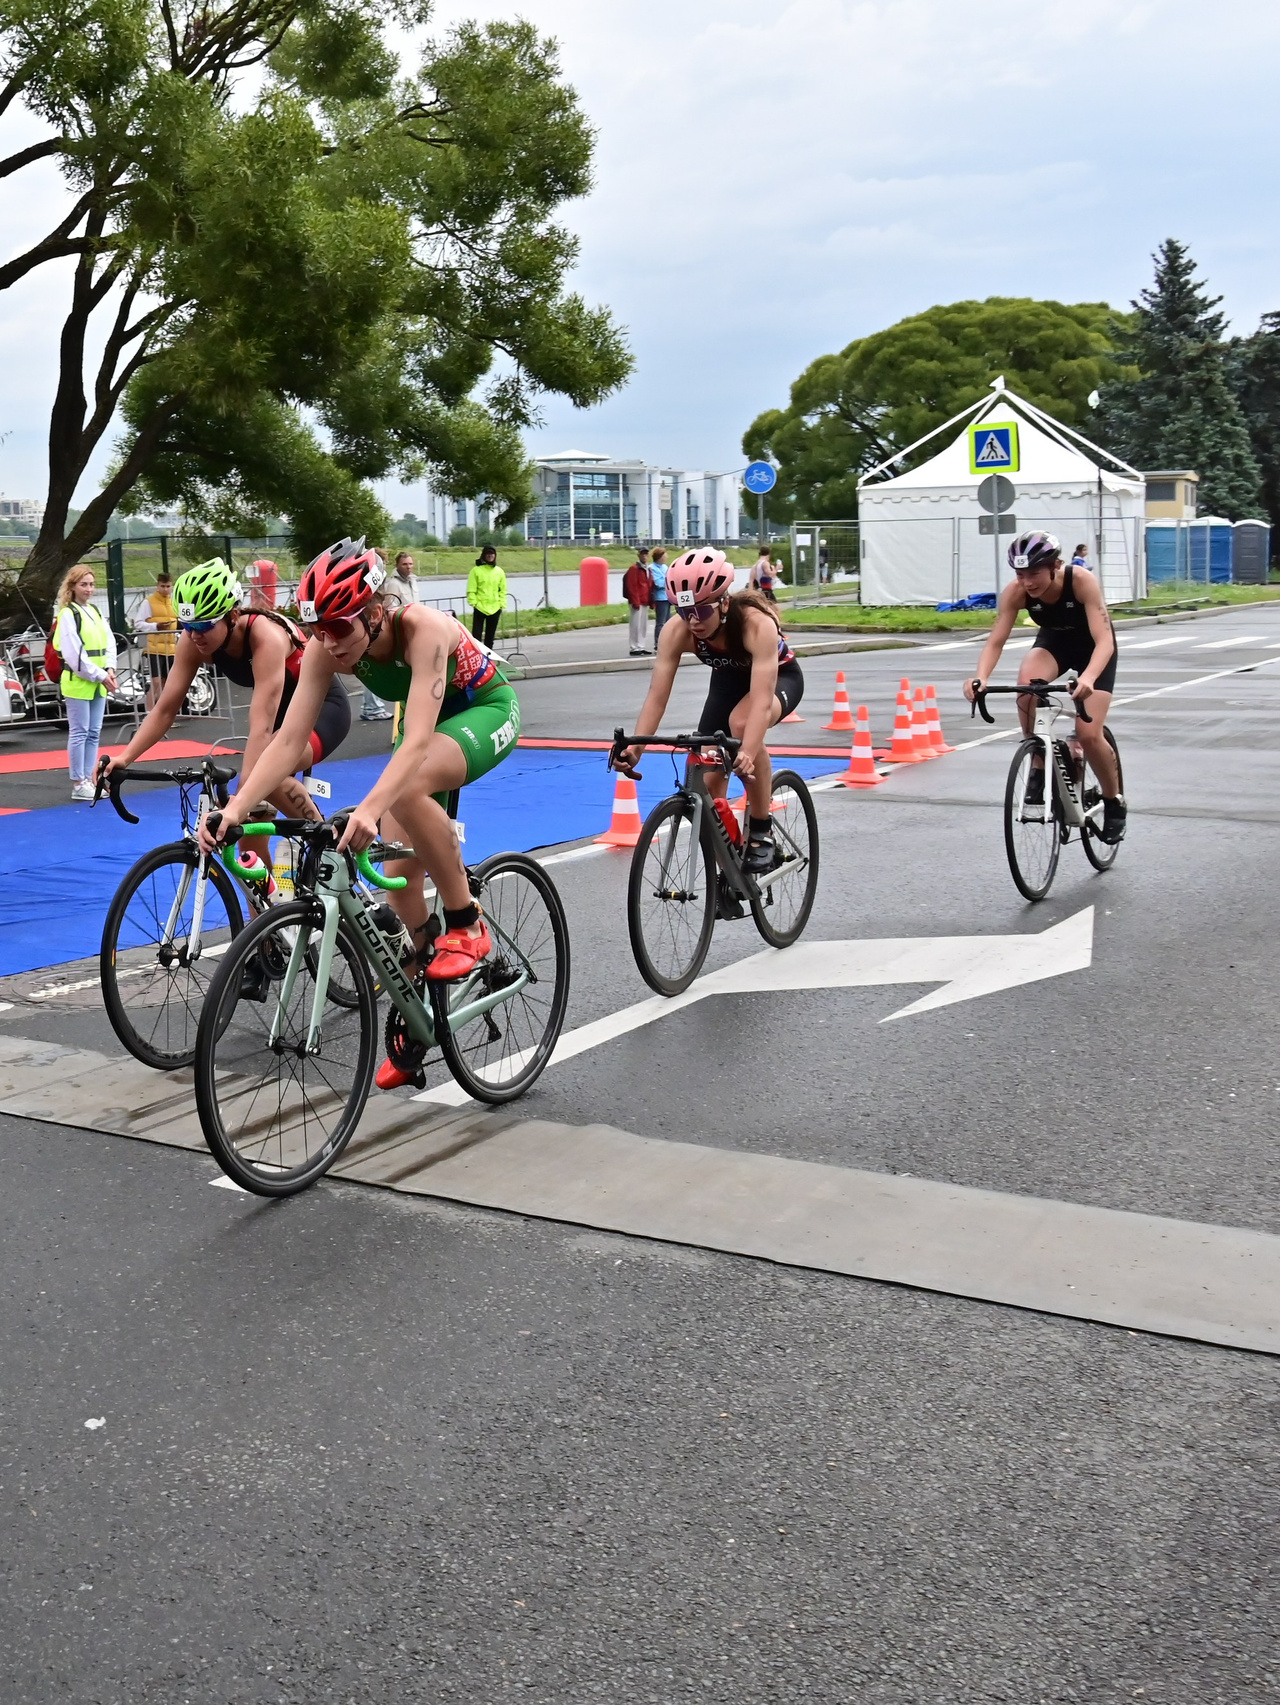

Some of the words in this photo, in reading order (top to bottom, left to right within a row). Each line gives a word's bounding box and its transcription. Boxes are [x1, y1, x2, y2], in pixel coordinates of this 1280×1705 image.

[371, 574, 381, 585] 60
[680, 594, 690, 603] 52
[181, 608, 191, 617] 56
[316, 783, 326, 794] 56
